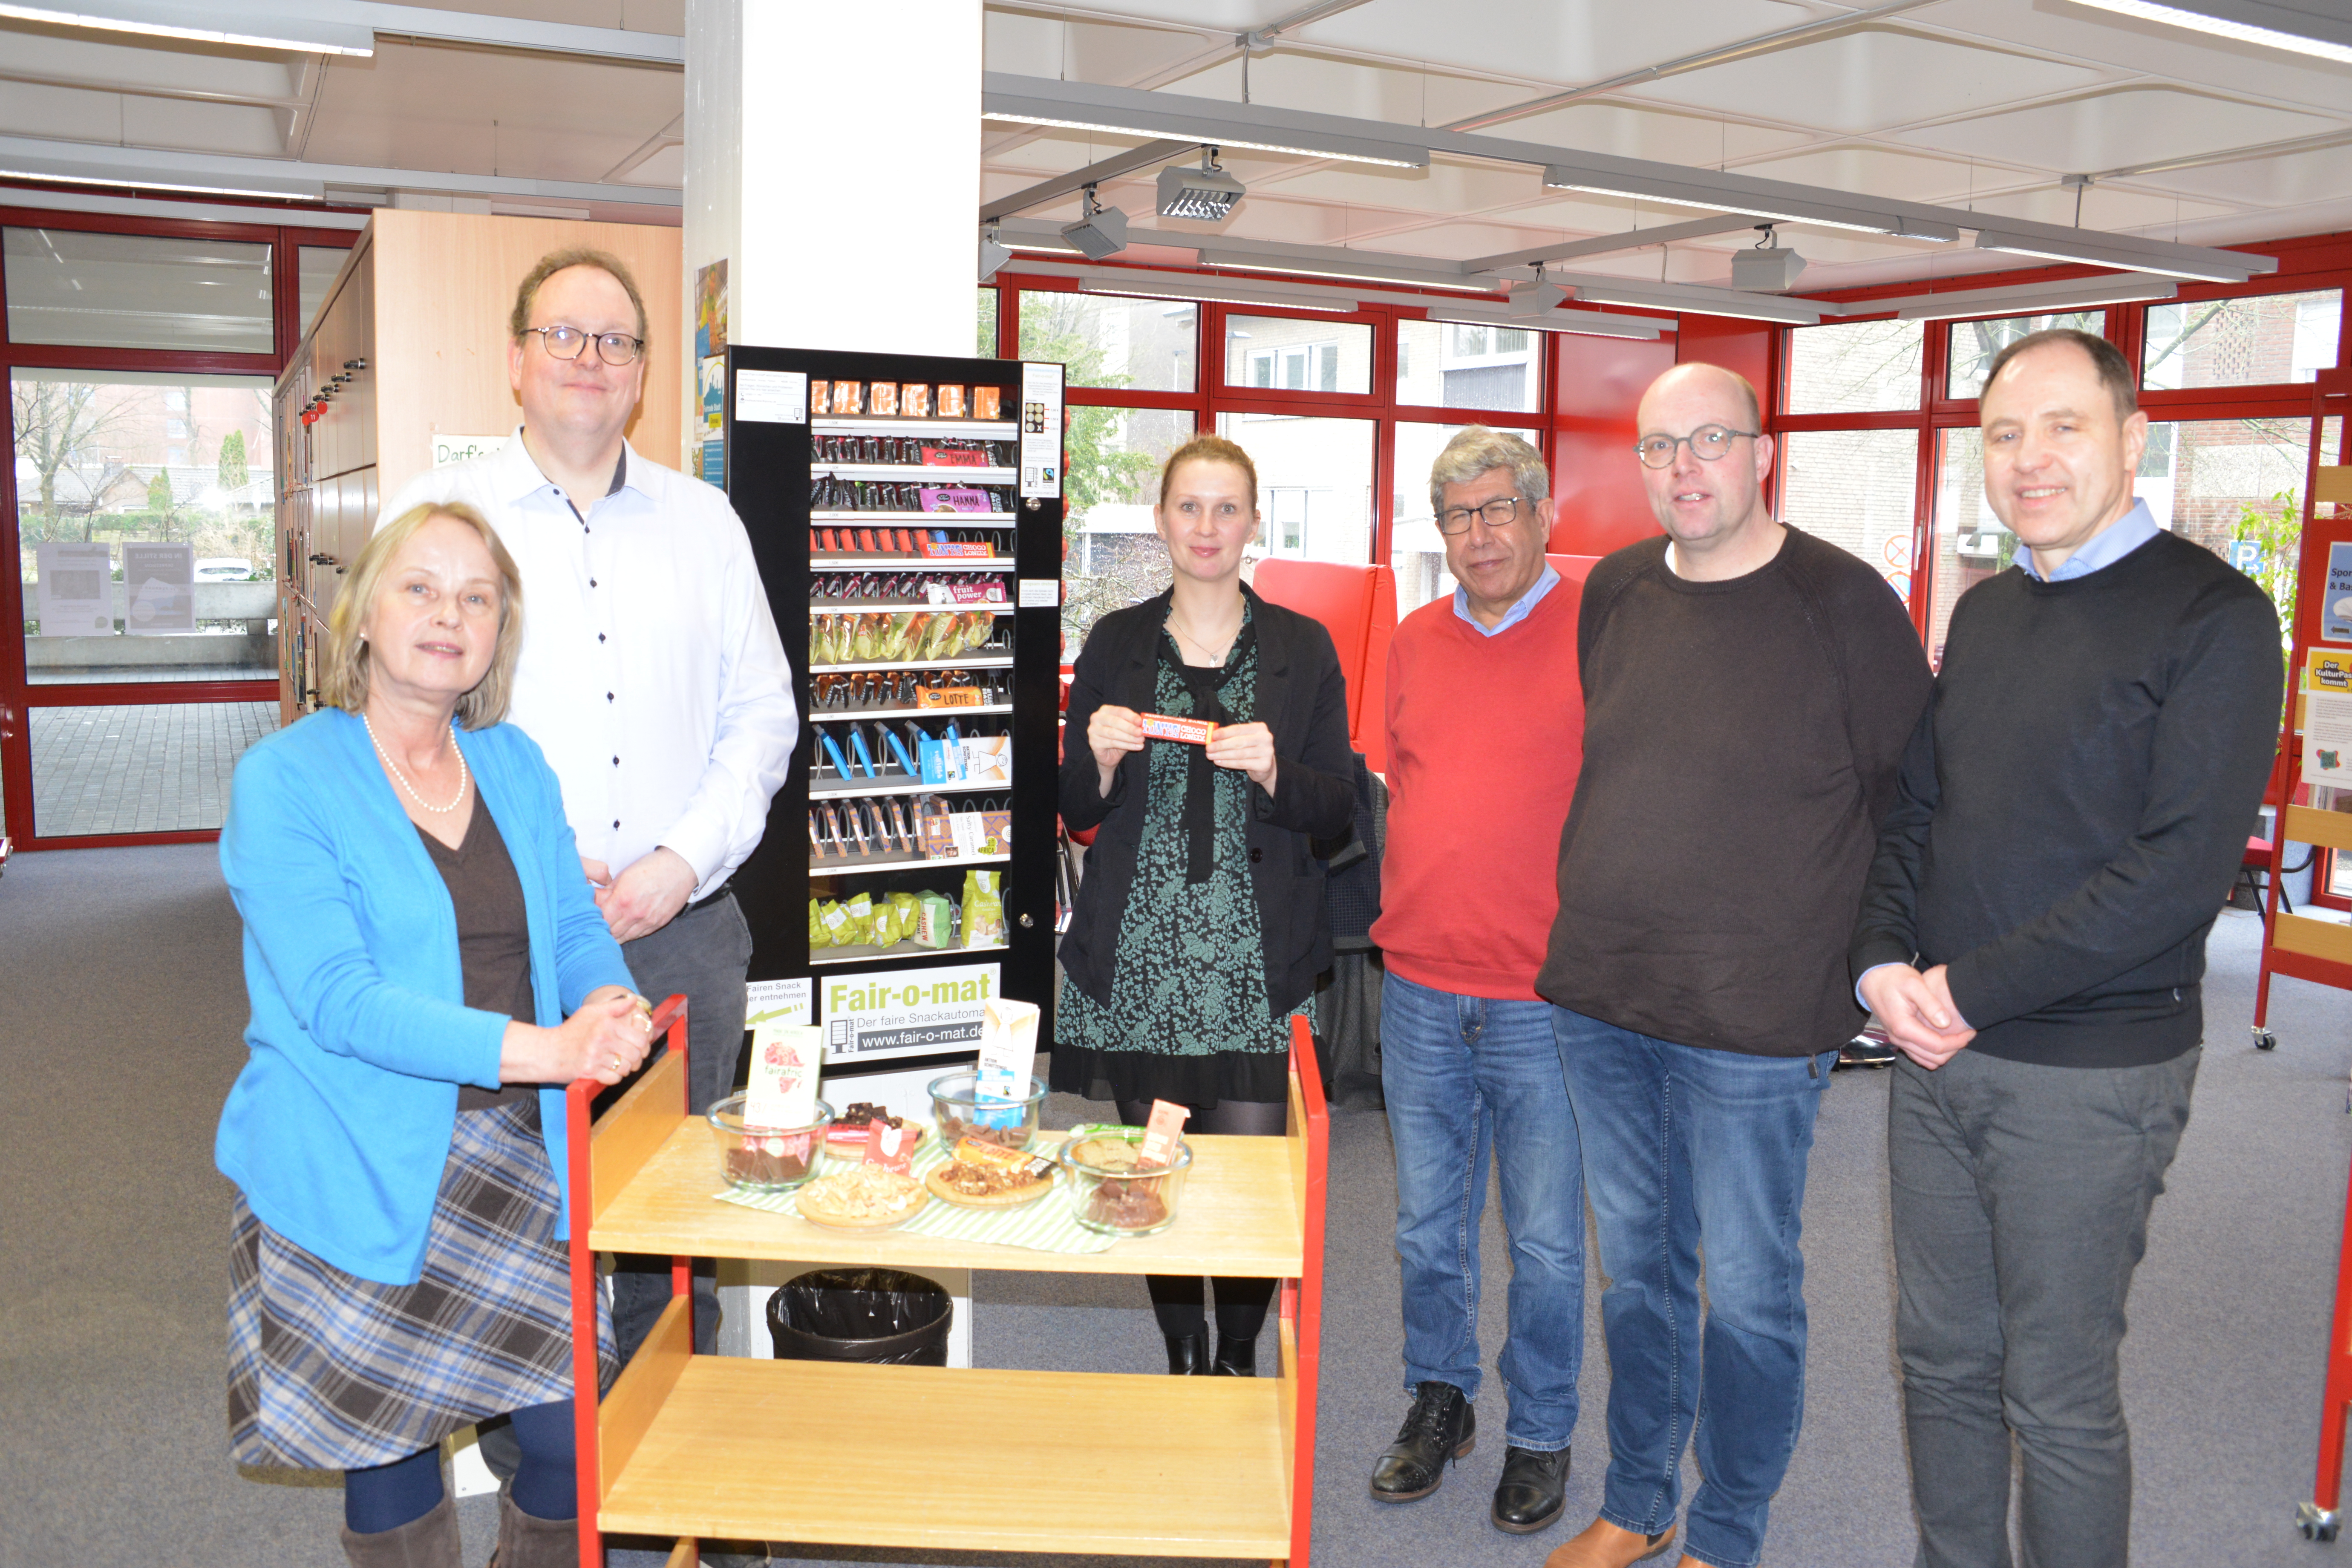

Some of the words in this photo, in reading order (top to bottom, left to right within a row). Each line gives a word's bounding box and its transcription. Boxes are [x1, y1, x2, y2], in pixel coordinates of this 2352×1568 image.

[949, 454, 977, 465] EMMA
[953, 496, 980, 507] HANNA
[927, 544, 963, 556] TONY'S
[2237, 545, 2257, 570] P
[2331, 568, 2352, 578] Spor
[953, 585, 974, 594] fruit
[2329, 582, 2336, 590] &
[2339, 582, 2352, 591] Bas
[957, 592, 982, 602] power
[2315, 669, 2352, 679] KulturPas
[2321, 677, 2347, 687] kommt
[944, 693, 969, 705] LOTTE
[1142, 719, 1181, 738] TONY'S
[1181, 725, 1207, 735] CHOCO
[968, 832, 977, 856] Caramel
[775, 982, 801, 990] Snack
[760, 992, 806, 1001] entnehmen
[857, 1017, 876, 1028] Der
[880, 1015, 905, 1026] faire
[909, 1009, 985, 1023] Snackautoma
[862, 1025, 983, 1048] www.fair-o-mat.de
[765, 1065, 802, 1078] fairafric
[980, 1146, 1013, 1159] LOTTE
[865, 1158, 907, 1173] Chews
